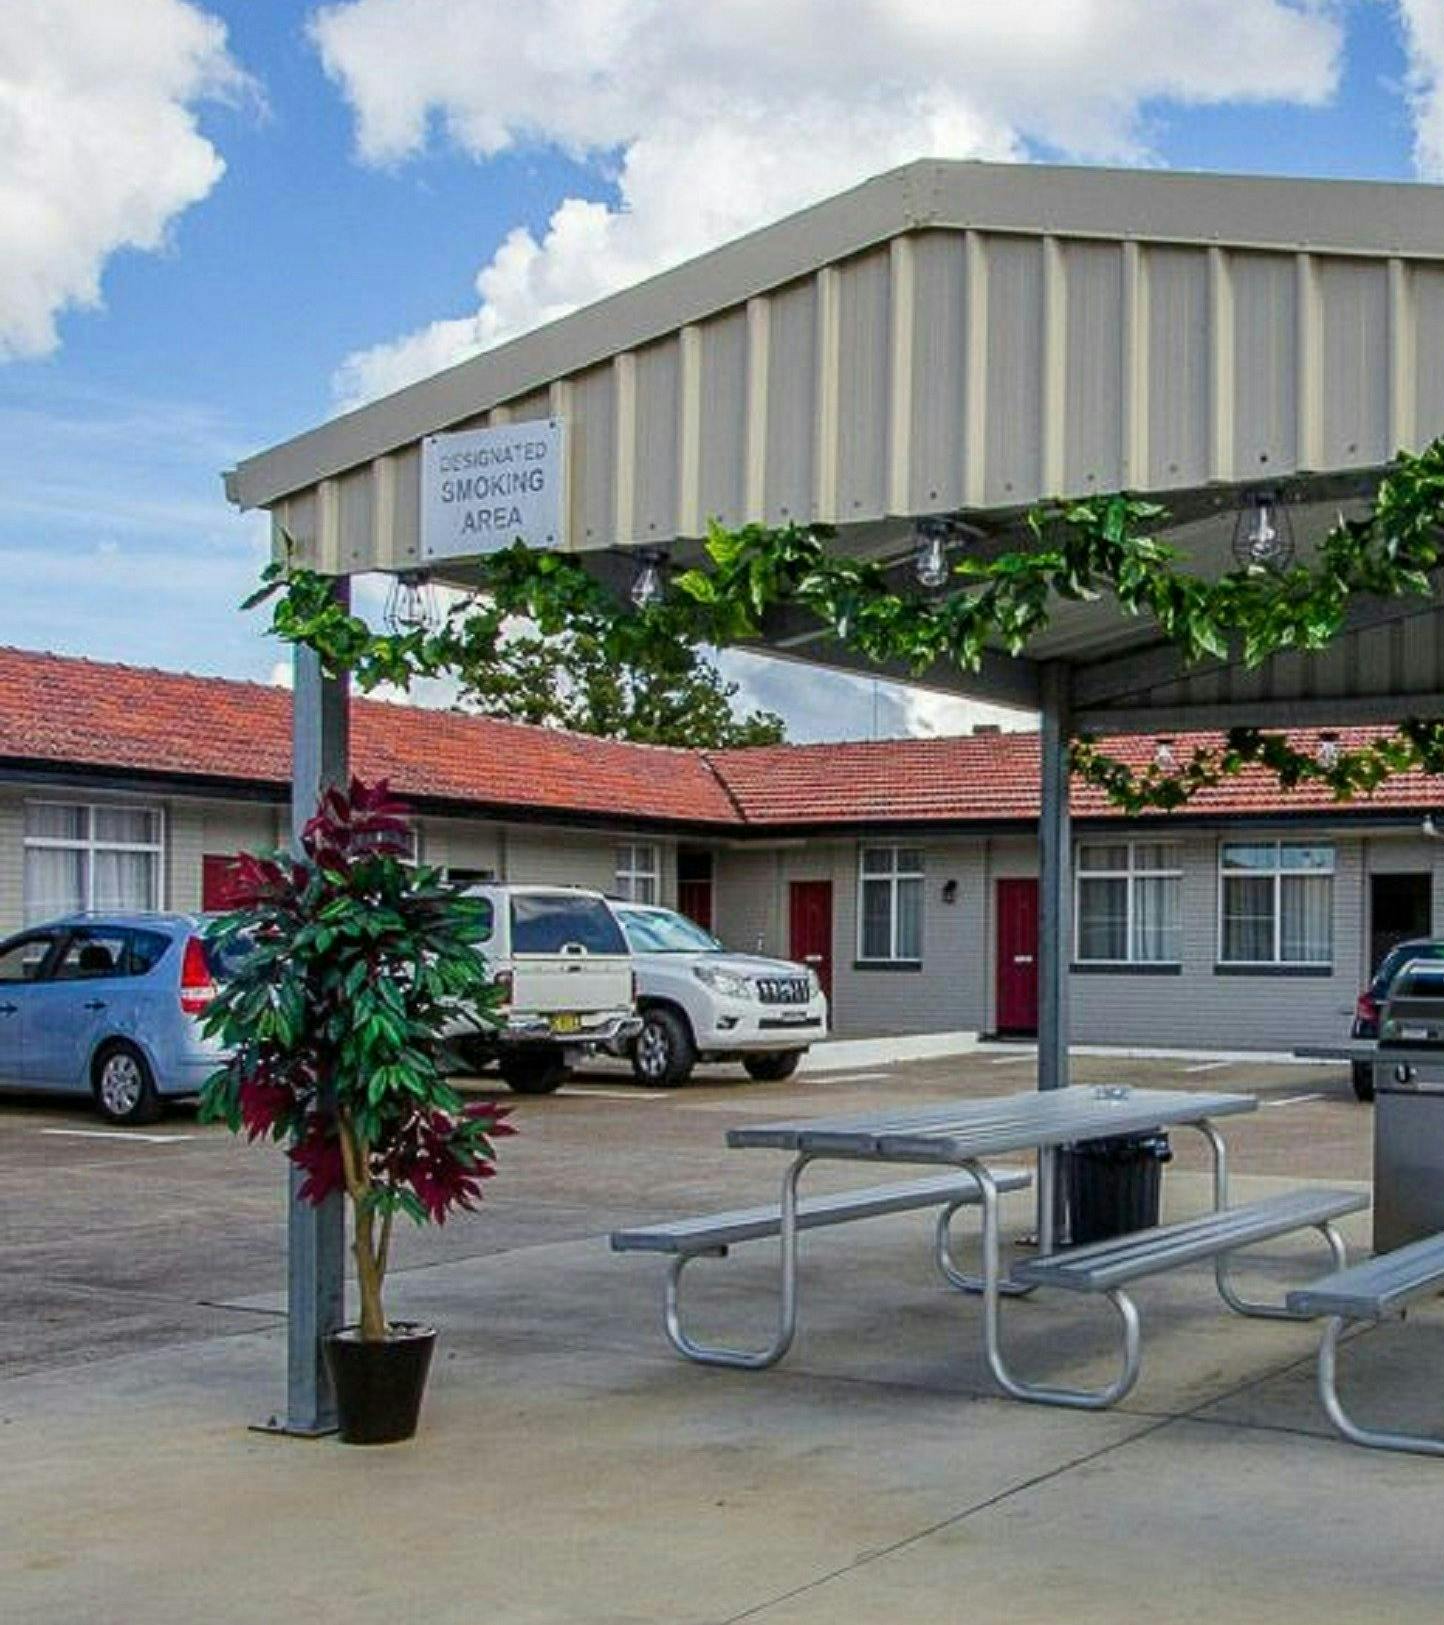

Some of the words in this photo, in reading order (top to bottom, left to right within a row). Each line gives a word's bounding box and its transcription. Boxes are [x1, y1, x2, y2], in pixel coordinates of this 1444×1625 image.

[440, 442, 547, 472] DESIGNATED
[441, 469, 544, 503] SMOKING
[462, 506, 522, 534] AREA
